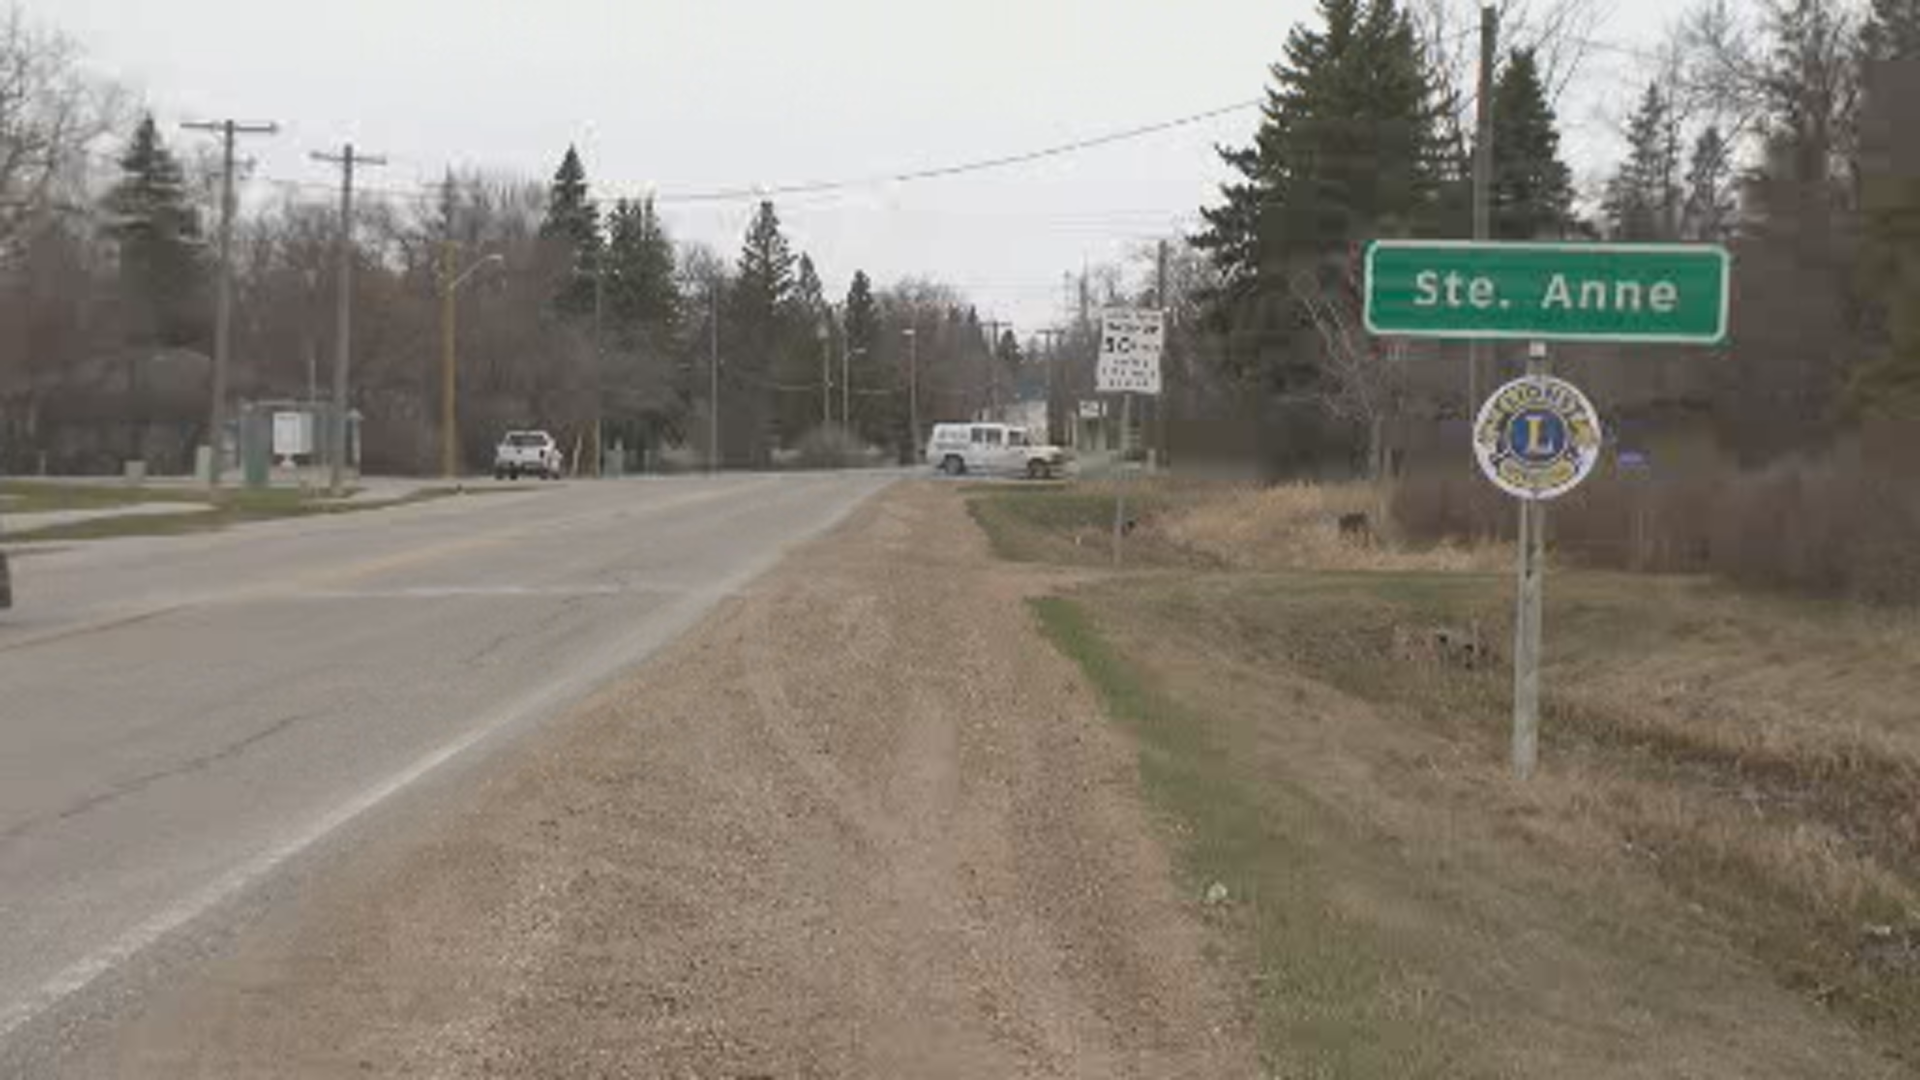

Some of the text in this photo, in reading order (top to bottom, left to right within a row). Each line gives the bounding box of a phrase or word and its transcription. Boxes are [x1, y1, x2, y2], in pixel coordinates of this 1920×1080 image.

[1413, 270, 1678, 312] Ste. Anne
[1525, 415, 1554, 454] L
